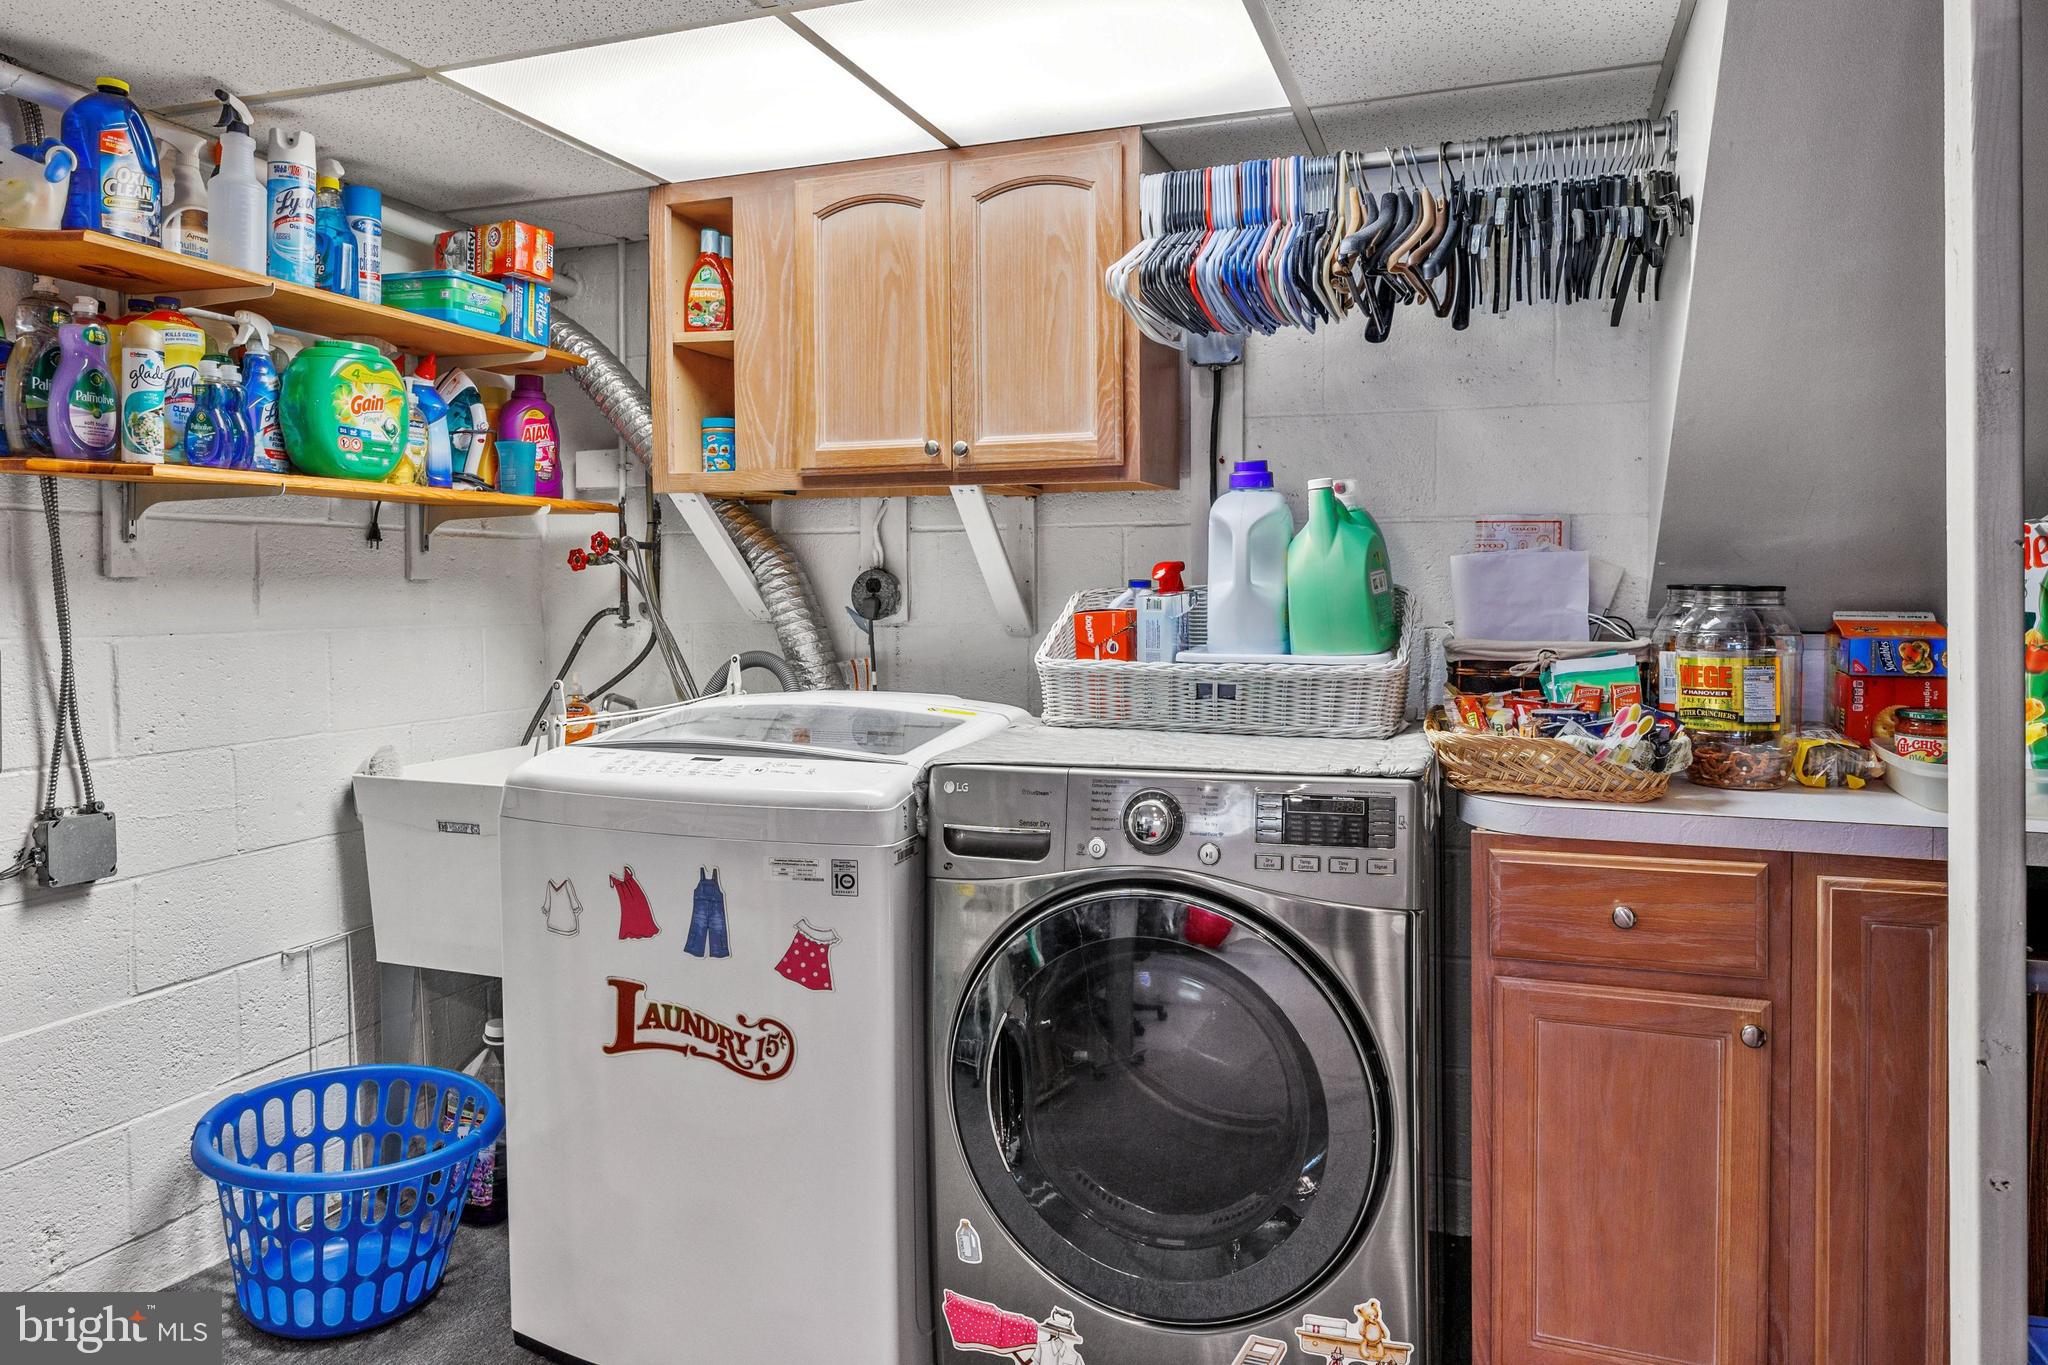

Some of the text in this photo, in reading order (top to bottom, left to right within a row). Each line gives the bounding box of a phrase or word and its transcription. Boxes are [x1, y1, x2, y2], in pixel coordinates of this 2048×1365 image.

[103, 178, 152, 201] CLEAN
[466, 231, 476, 271] Hefty
[75, 389, 115, 406] Palmolive
[350, 394, 385, 416] Gain
[521, 423, 551, 443] AJAX
[1085, 614, 1095, 645] bounce
[1880, 640, 1898, 672] Sociables
[1680, 665, 1733, 689] WEGE
[1615, 686, 1635, 696] Lance
[1696, 709, 1737, 720] CRUNCHERS
[1896, 737, 1944, 759] CHI-CHI'S
[956, 782, 969, 793] LG
[1019, 819, 1051, 829] Sensor Dry
[834, 873, 856, 890] 10
